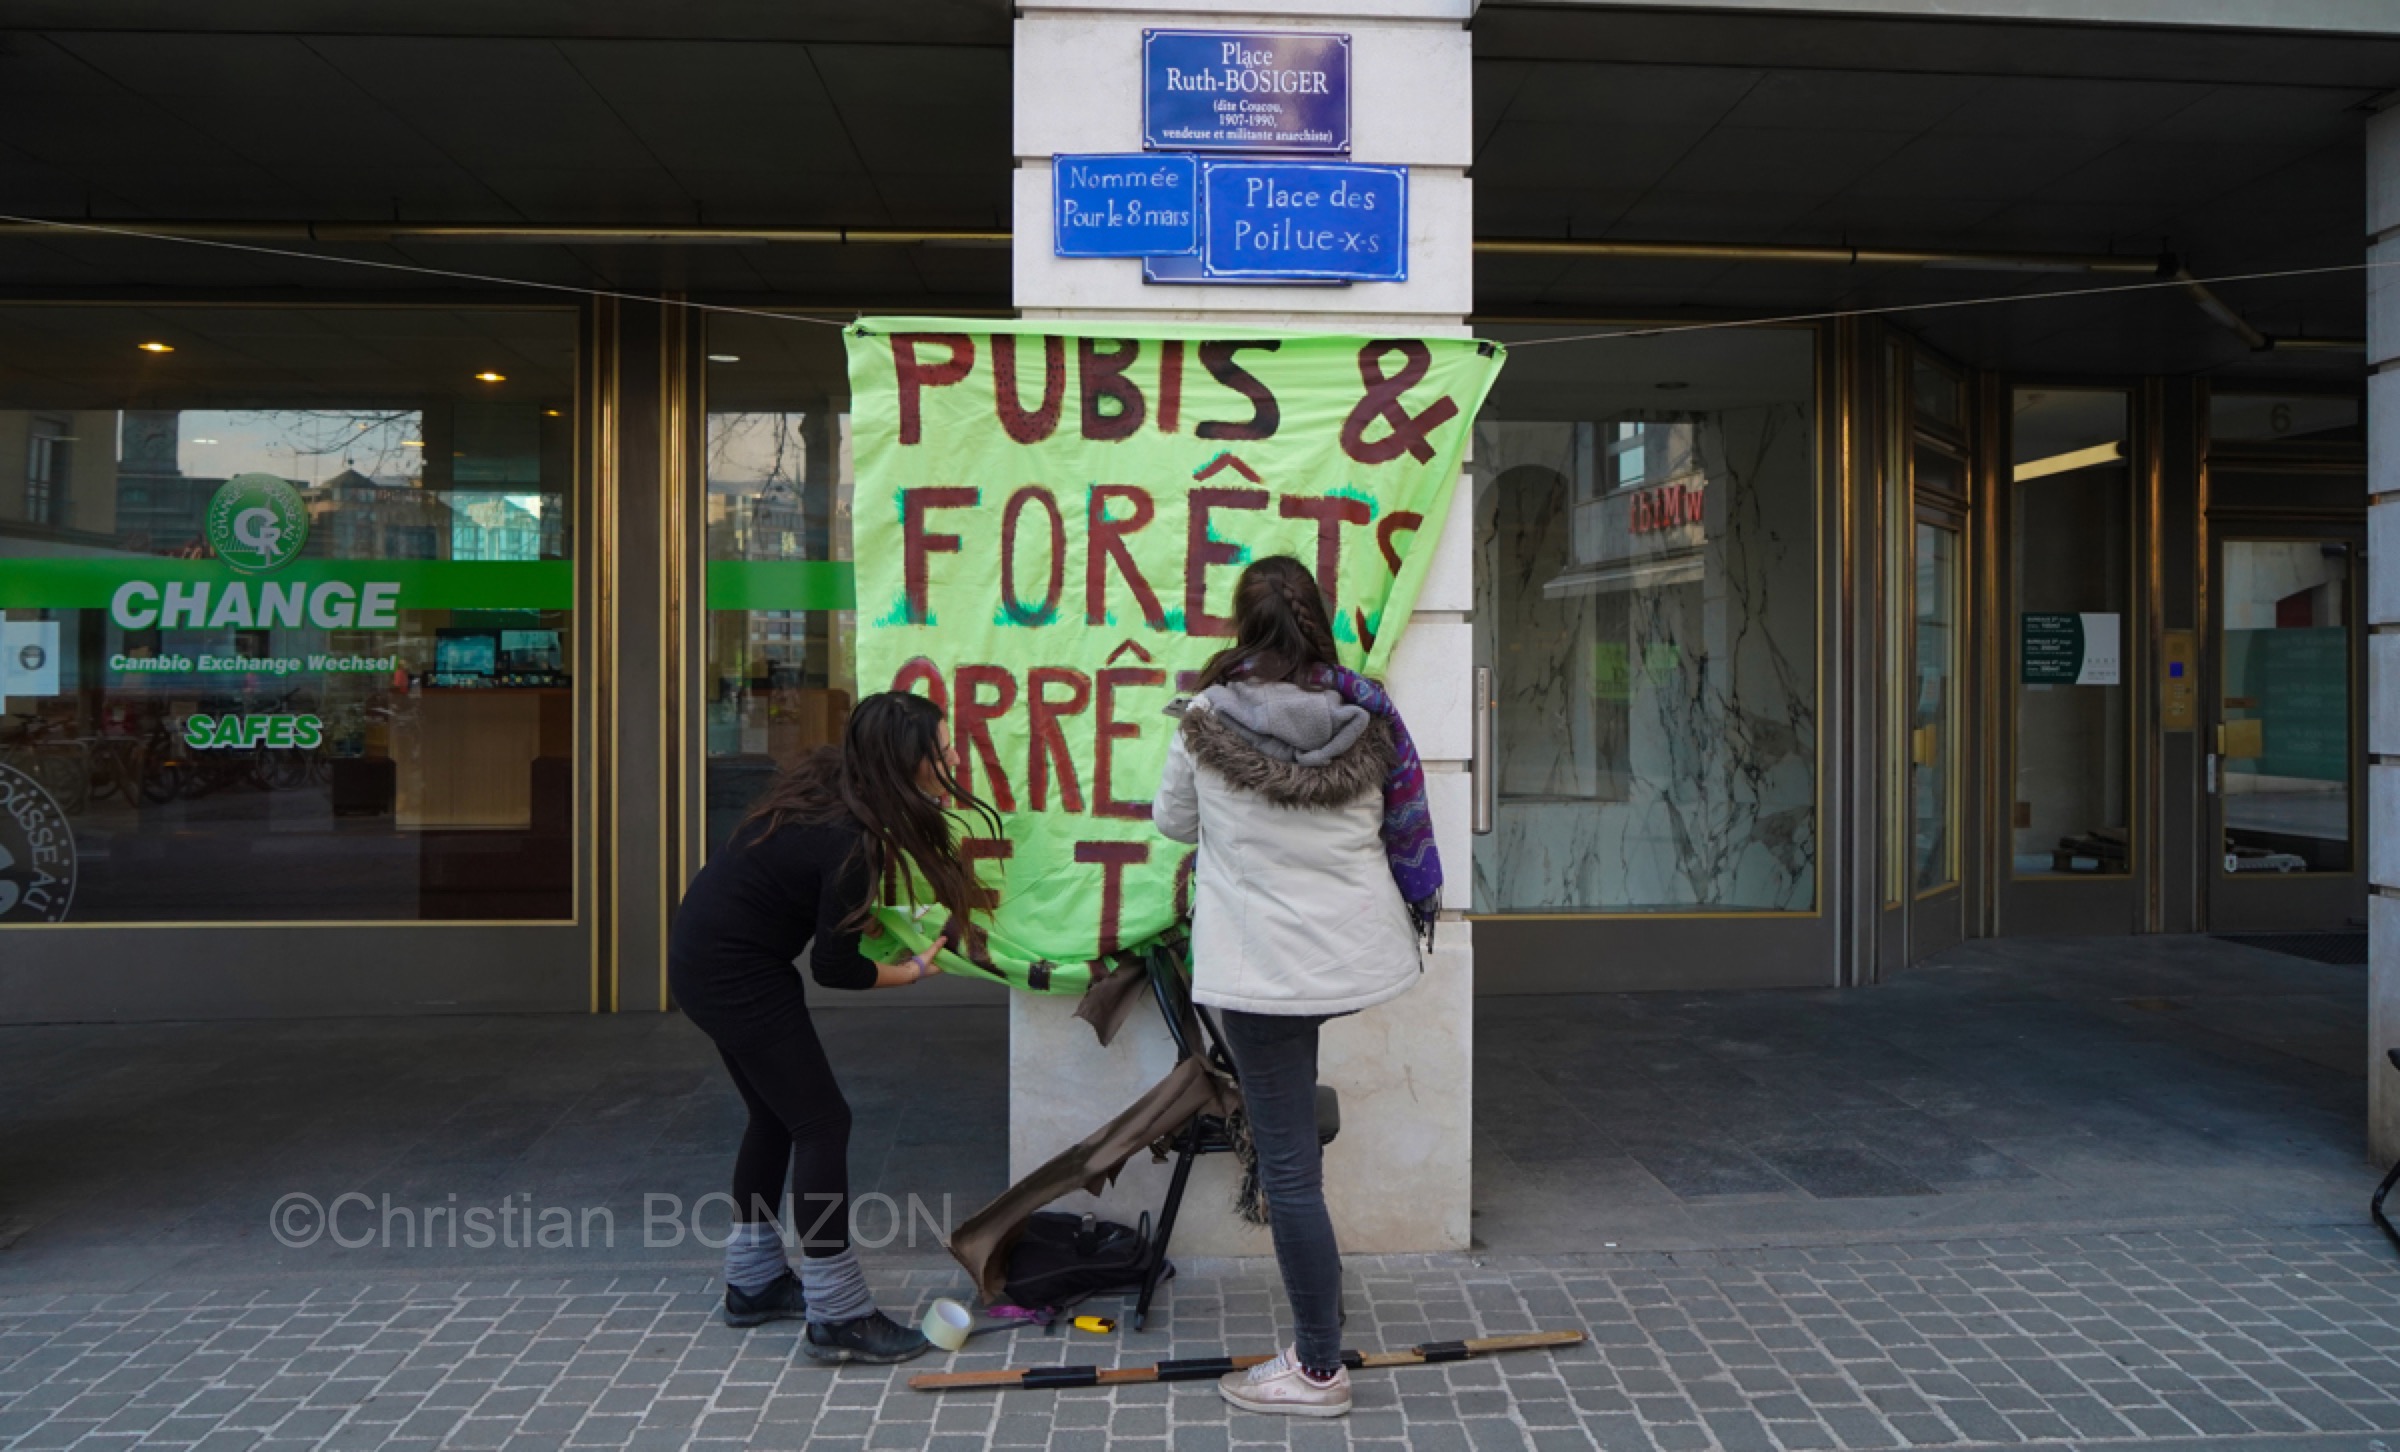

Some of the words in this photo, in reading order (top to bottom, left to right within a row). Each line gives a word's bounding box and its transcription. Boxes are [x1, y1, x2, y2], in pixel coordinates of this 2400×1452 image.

[1221, 42, 1273, 66] Place
[1166, 63, 1329, 94] Ruth-BÖSIGER
[1213, 99, 1237, 113] (dite
[1239, 99, 1283, 114] Coucou,
[1162, 126, 1211, 139] vendeuse
[1213, 128, 1225, 139] et
[1226, 127, 1273, 141] militante
[1276, 129, 1333, 143] anarchiste)
[1219, 114, 1278, 128] 1907-1990,
[1071, 165, 1179, 189] Nommée
[1246, 178, 1321, 209] Place
[1329, 180, 1376, 210] des
[1063, 200, 1103, 227] Pour
[1104, 200, 1123, 227] le
[1127, 200, 1142, 226] 8
[1145, 208, 1189, 227] mars
[889, 332, 1282, 445] PUBIS
[1340, 338, 1459, 466] &
[2270, 403, 2292, 432] 6
[111, 581, 401, 631] CHANGE
[109, 653, 192, 672] Cambio
[197, 653, 301, 677] Exchange
[306, 653, 398, 672] Wechsel
[184, 714, 323, 750] SAFES
